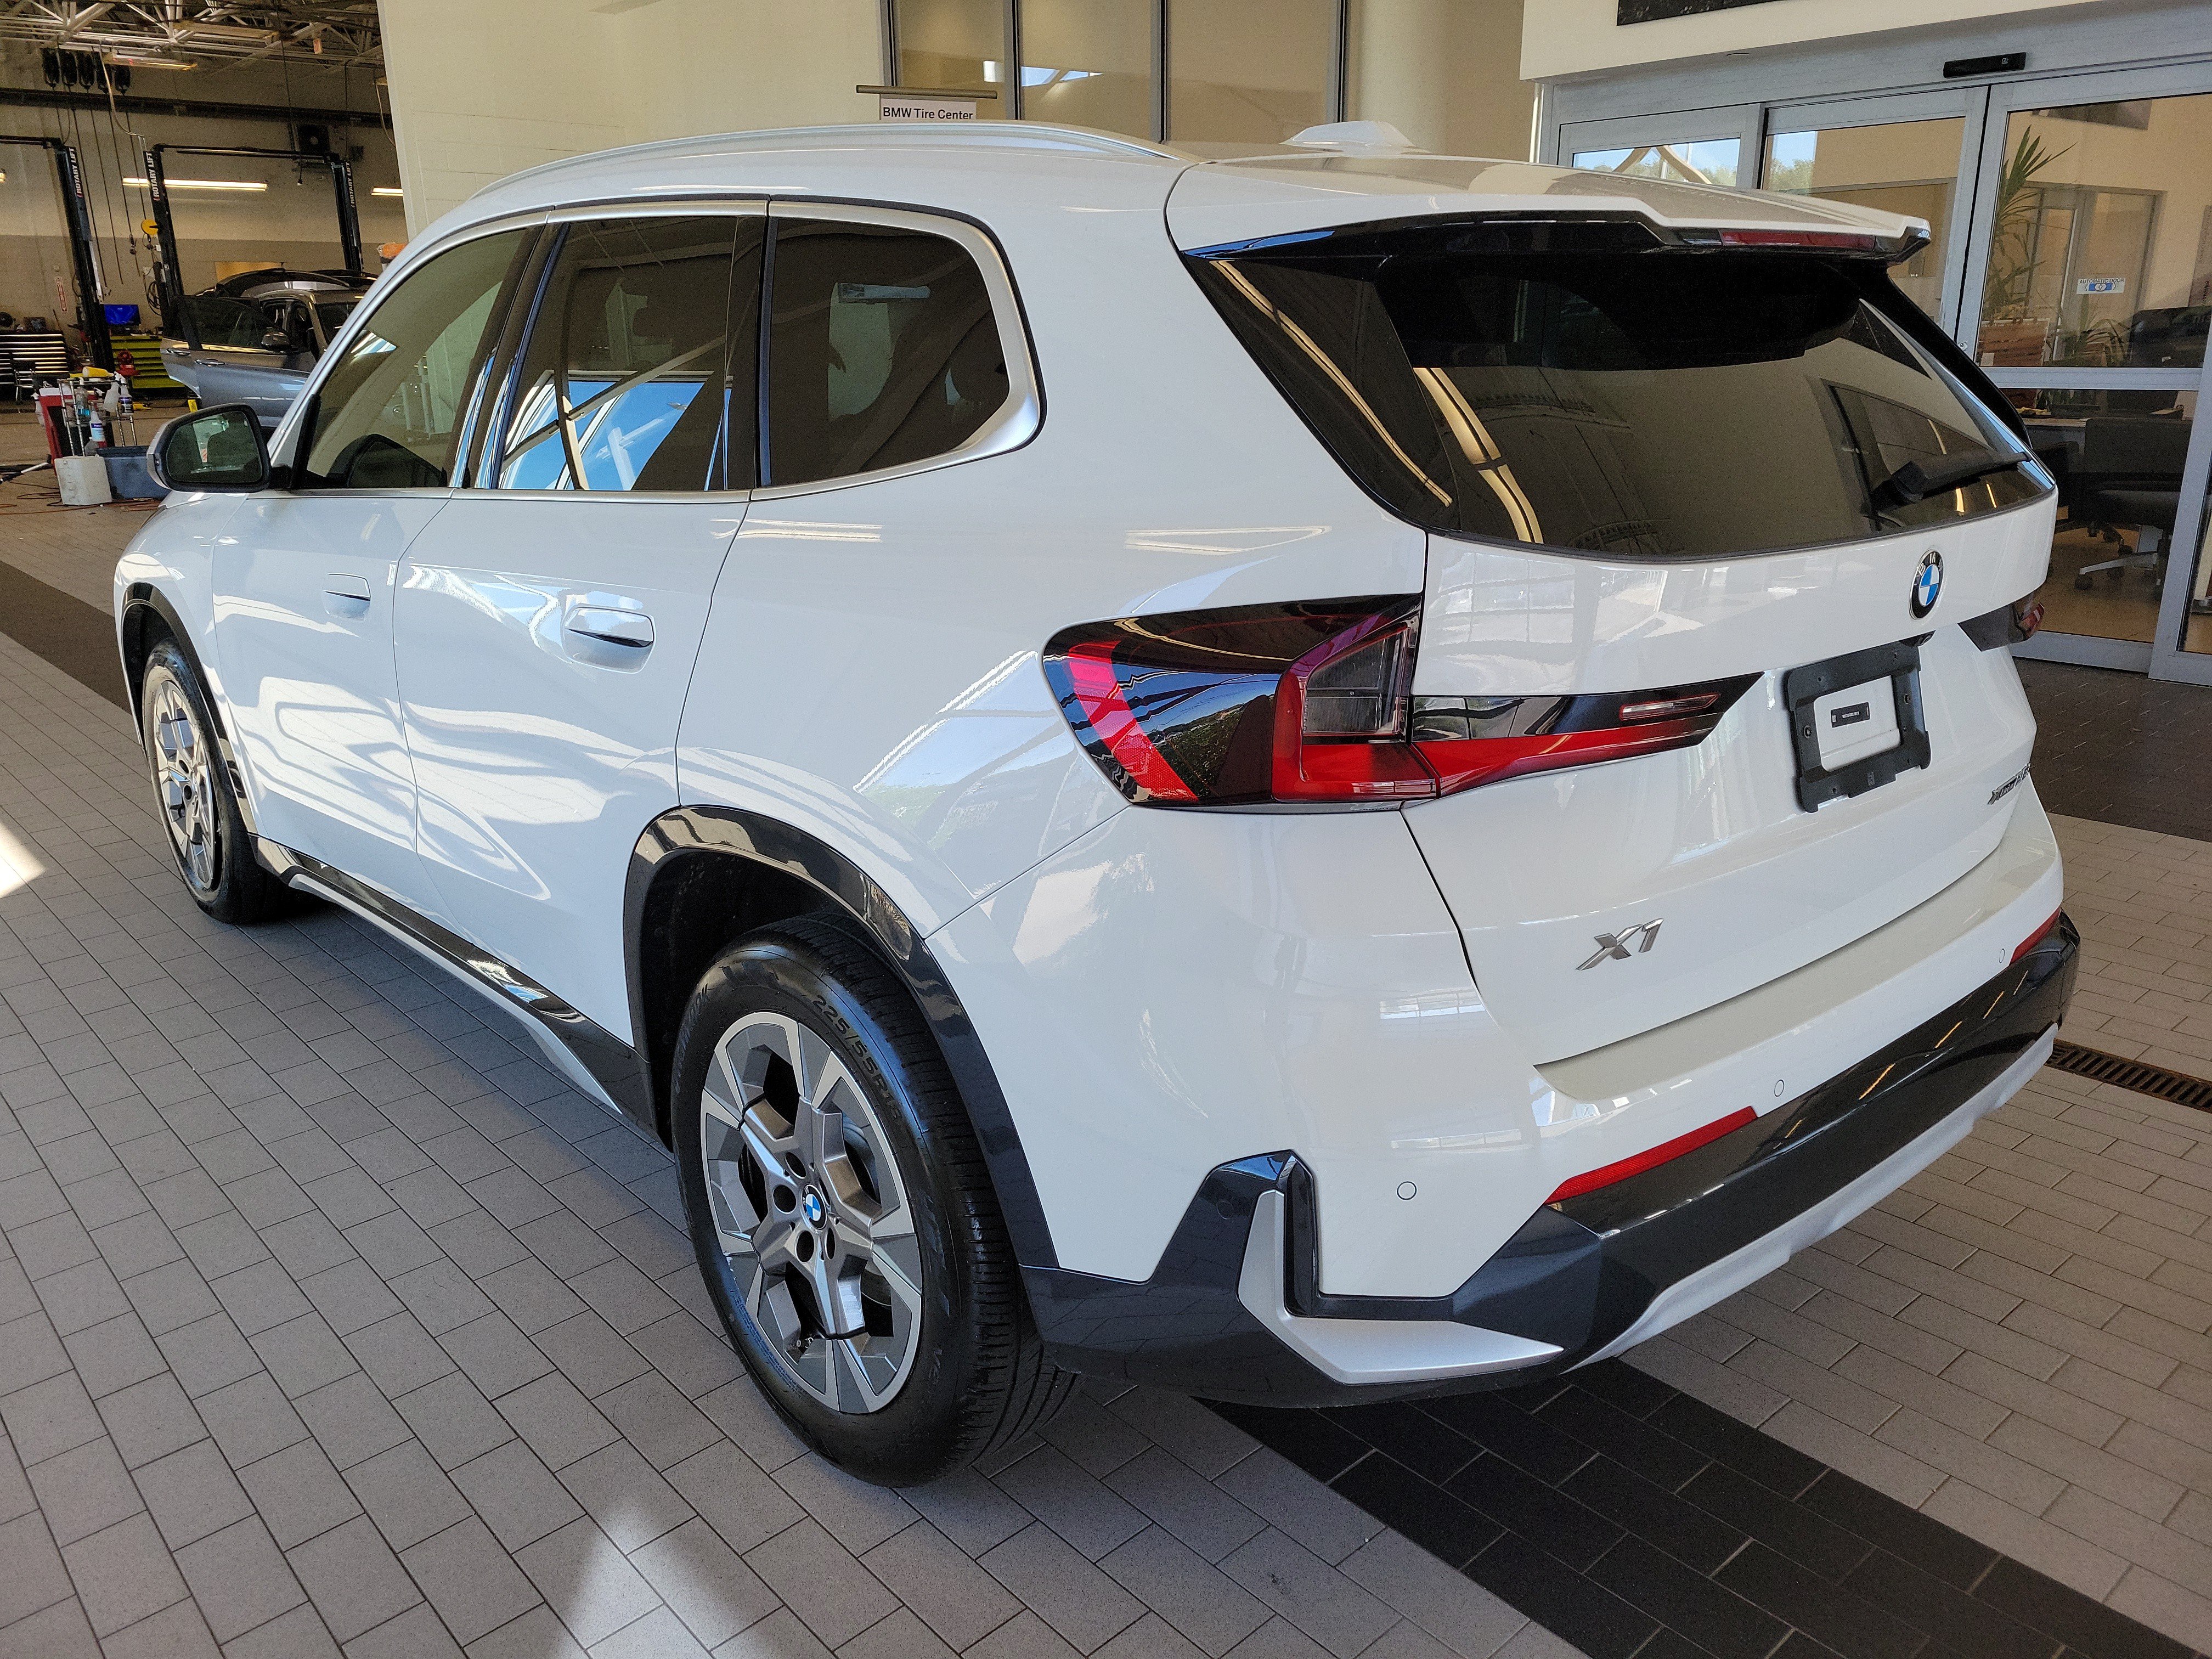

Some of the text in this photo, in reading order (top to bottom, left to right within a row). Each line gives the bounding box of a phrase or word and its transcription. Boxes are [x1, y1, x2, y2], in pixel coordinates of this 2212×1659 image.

[883, 107, 973, 120] BMW Tire Center
[69, 147, 82, 194] ROTARY LIFT
[145, 152, 160, 197] ROTARY LIFT
[1574, 918, 1664, 971] X1
